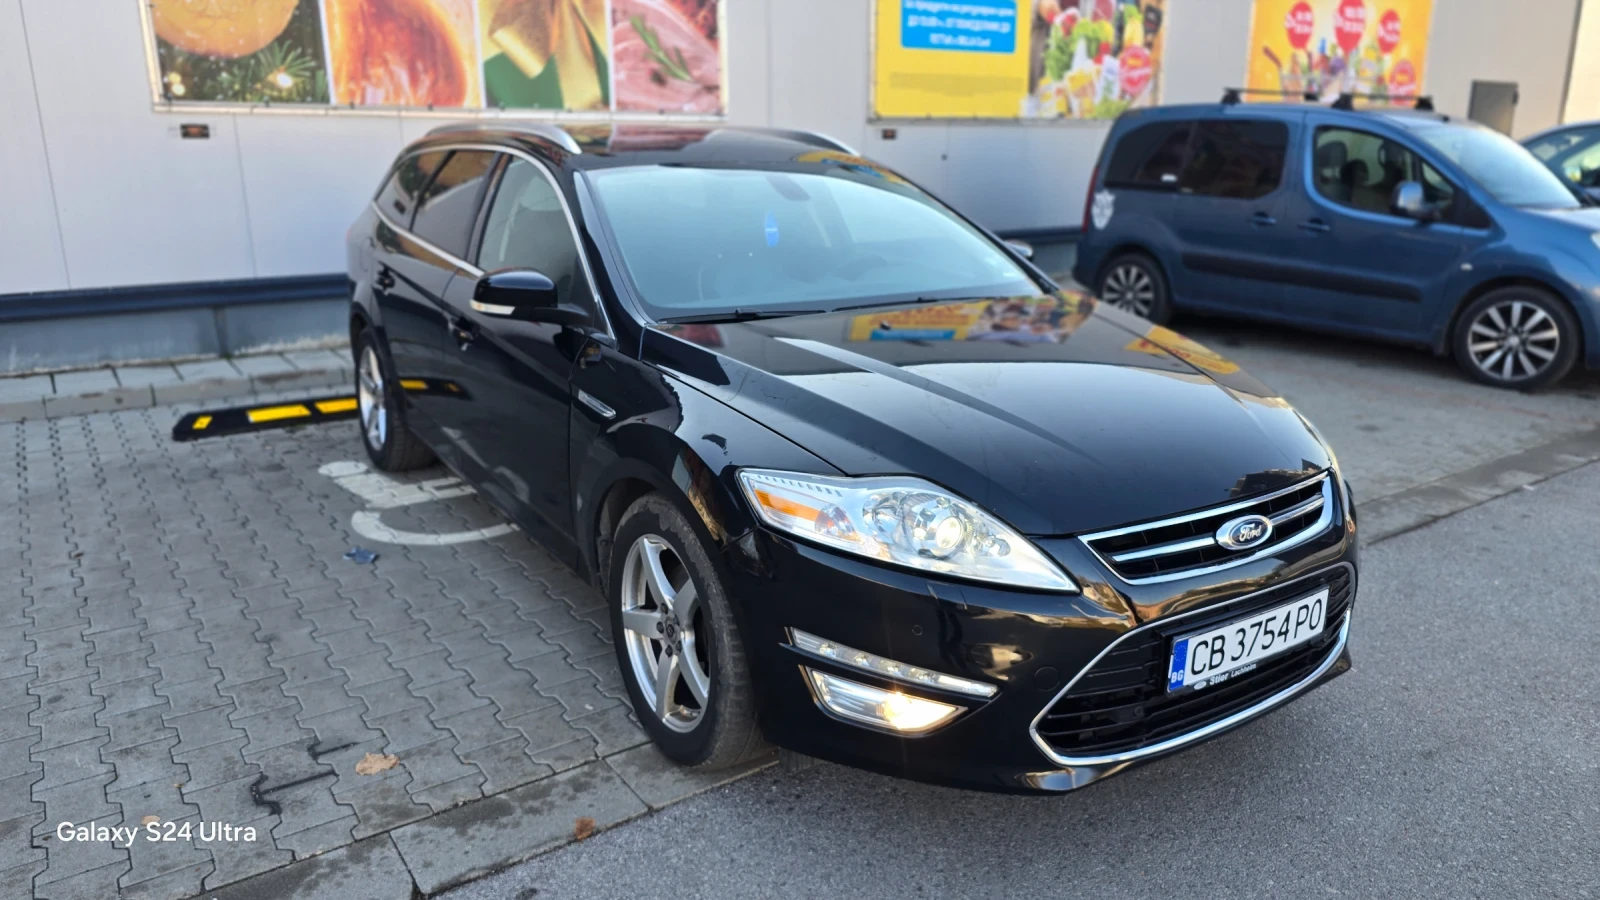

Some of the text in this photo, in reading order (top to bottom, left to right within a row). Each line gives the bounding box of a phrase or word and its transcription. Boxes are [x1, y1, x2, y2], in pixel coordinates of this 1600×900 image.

[1239, 523, 1262, 541] Ford
[1191, 598, 1322, 675] CB 3754 PO
[1171, 670, 1184, 683] BG
